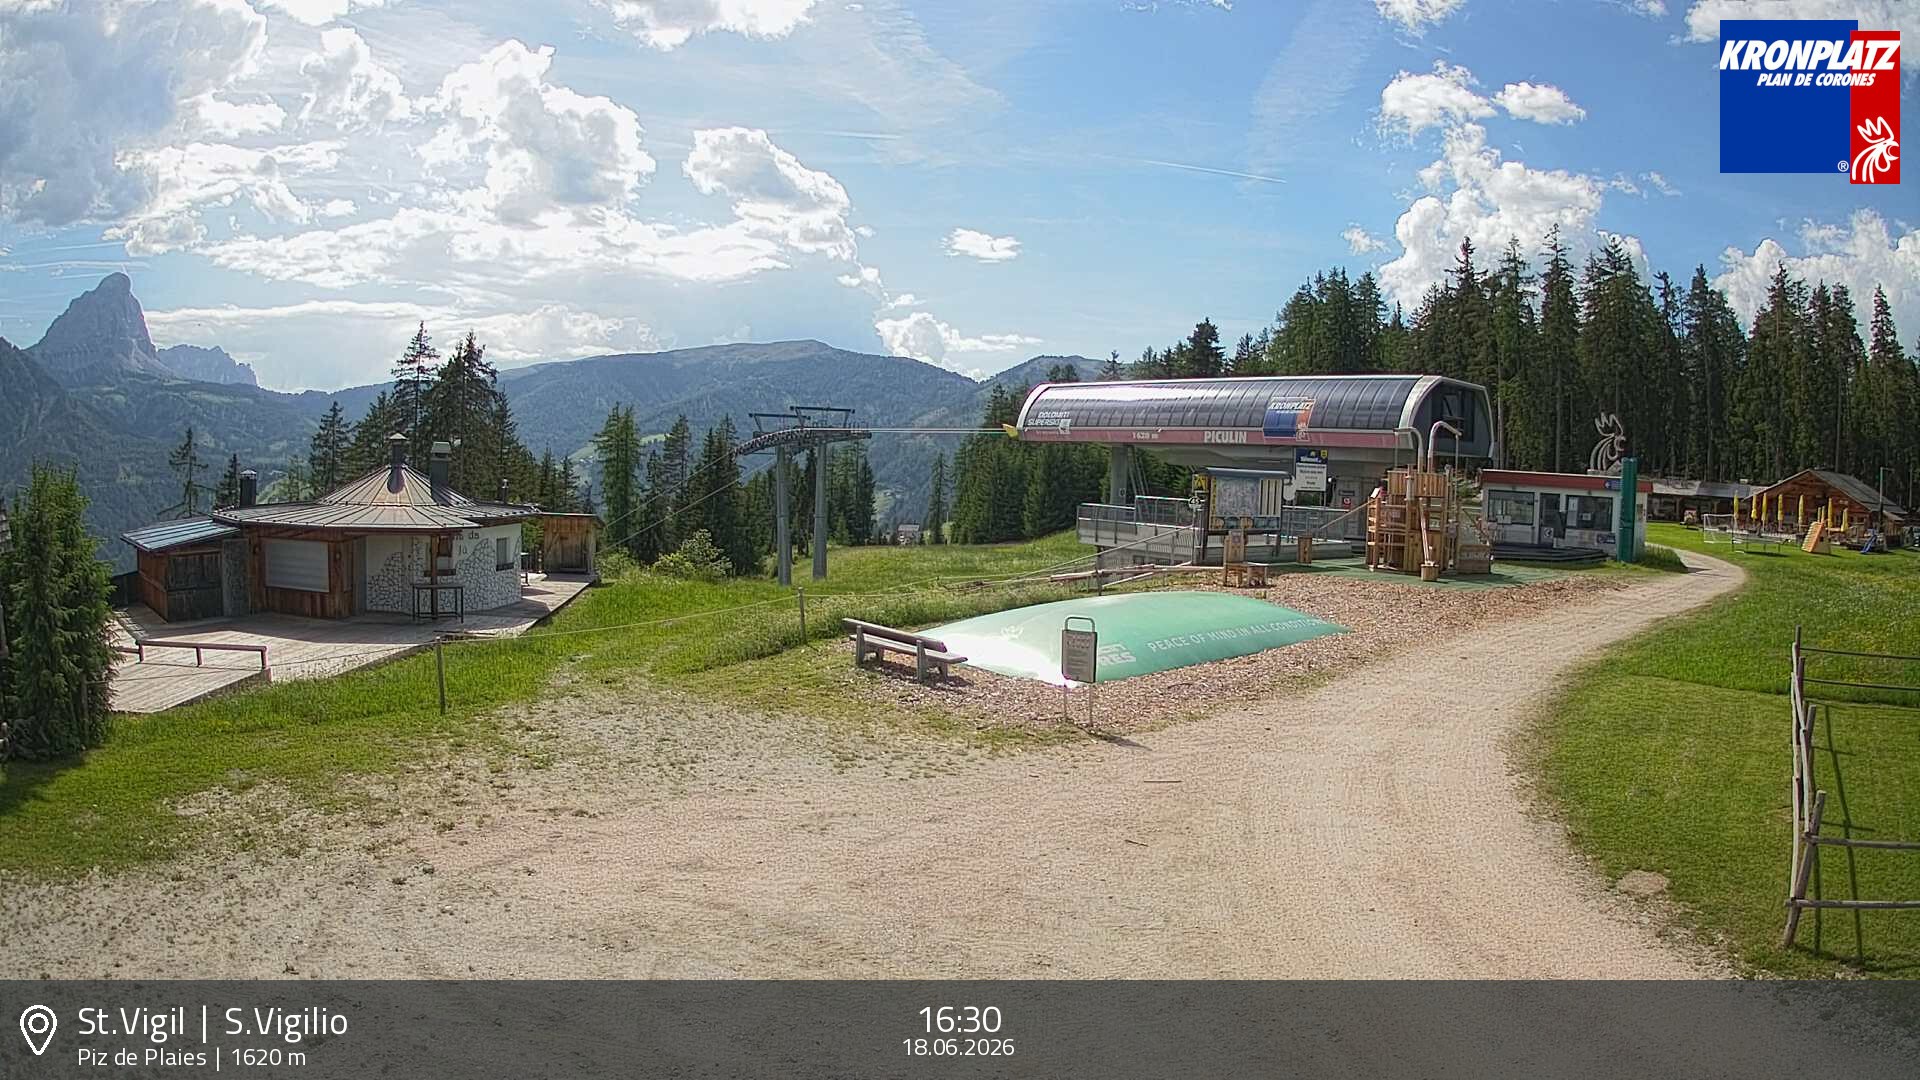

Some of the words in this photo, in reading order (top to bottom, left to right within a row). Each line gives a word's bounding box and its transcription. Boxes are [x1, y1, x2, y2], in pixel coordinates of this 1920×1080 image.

[1268, 401, 1314, 410] KRONPLATZ
[1038, 411, 1070, 419] DOLOMITI
[1028, 418, 1061, 426] SUPERSKI
[1204, 430, 1247, 443] PICULIN
[1147, 636, 1190, 653] PEACE
[1190, 633, 1206, 644] OF
[1207, 629, 1237, 641] MIND
[1237, 627, 1250, 637] IN
[1250, 624, 1272, 635] ALL
